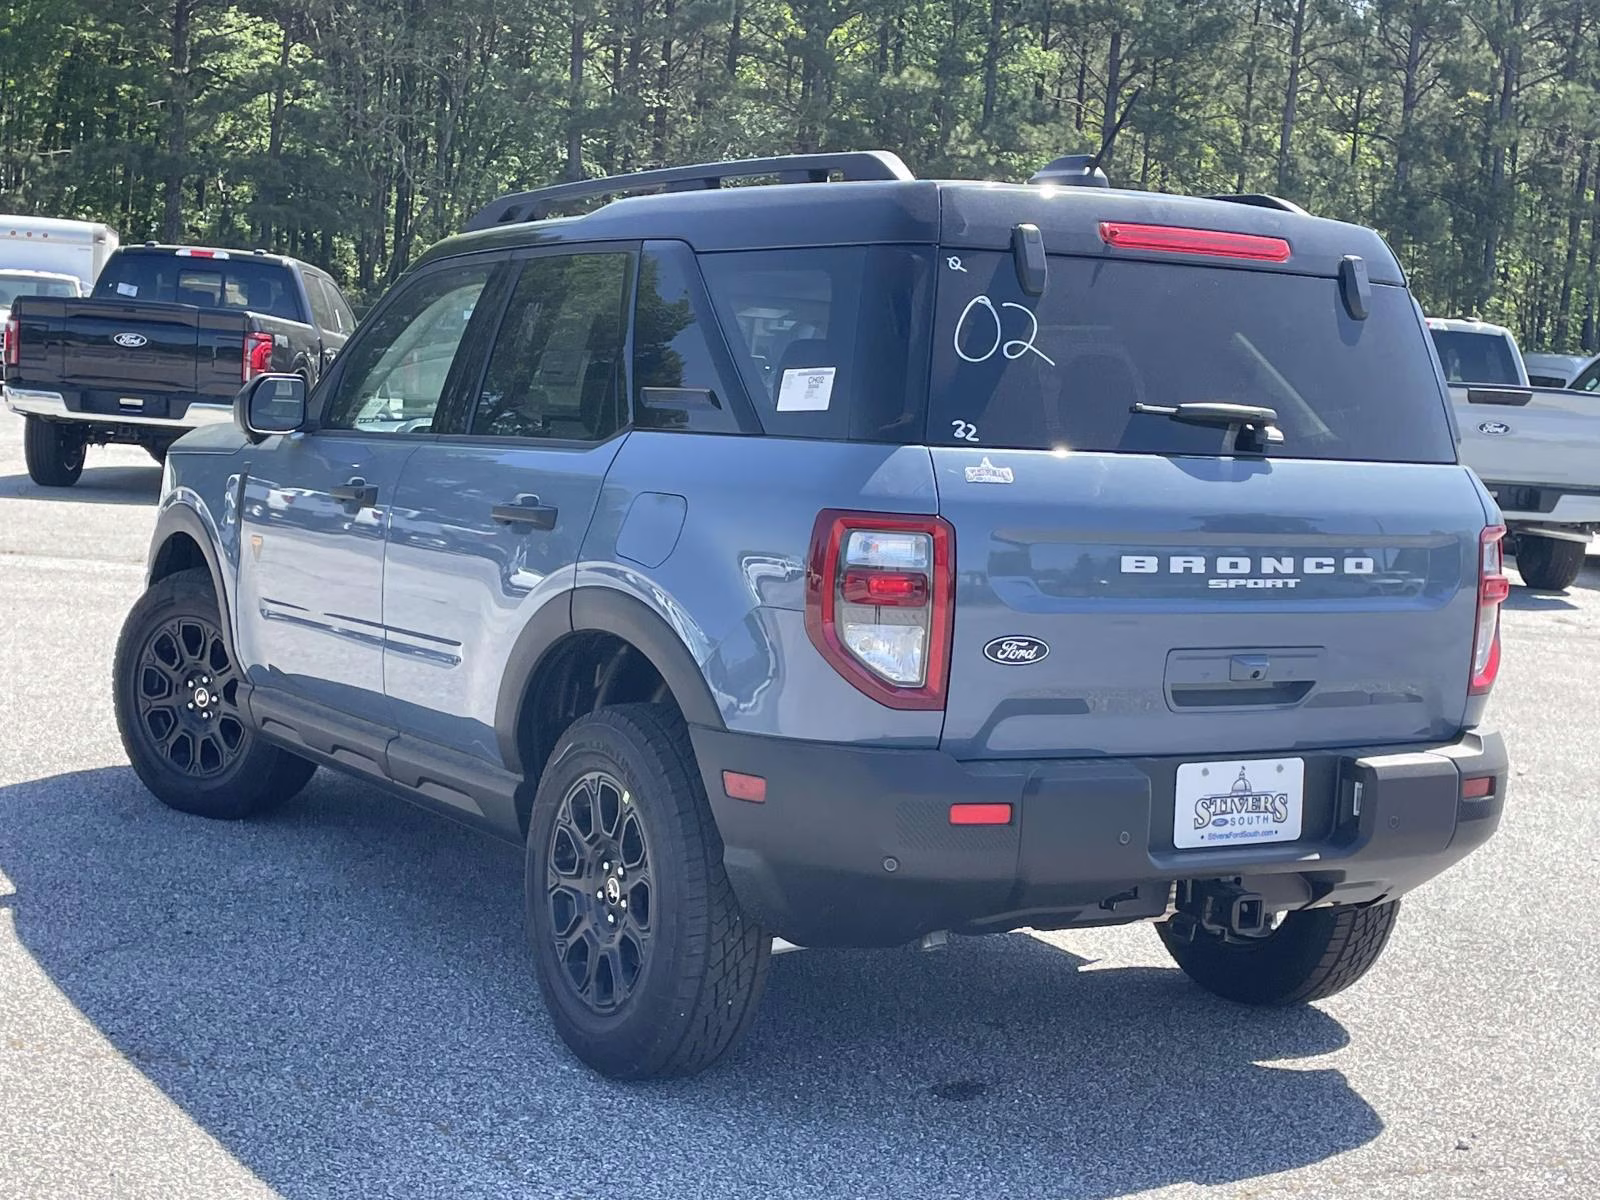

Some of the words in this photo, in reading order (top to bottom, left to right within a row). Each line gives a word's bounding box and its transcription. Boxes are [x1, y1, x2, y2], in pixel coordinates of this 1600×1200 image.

[1120, 555, 1374, 575] BRONCO
[1208, 578, 1300, 589] SPORT
[997, 641, 1039, 659] Ford
[1194, 793, 1288, 830] STIVERS
[1230, 815, 1269, 826] SOUTH
